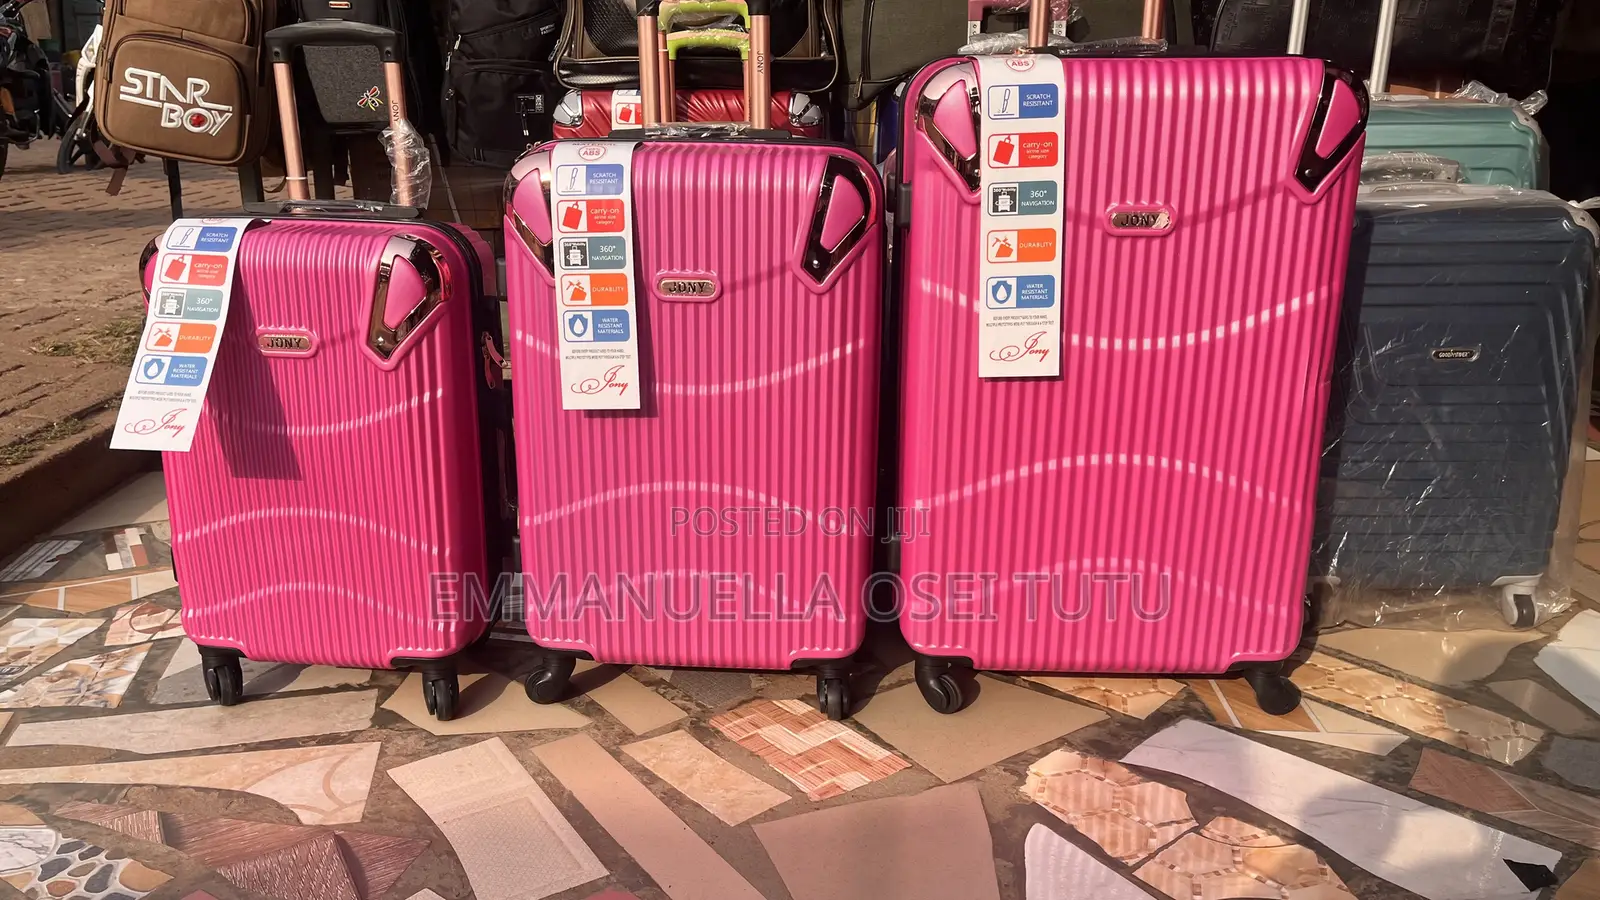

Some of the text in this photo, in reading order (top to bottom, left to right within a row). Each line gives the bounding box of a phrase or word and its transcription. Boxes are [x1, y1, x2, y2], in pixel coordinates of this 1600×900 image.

[756, 50, 765, 75] JONY
[120, 67, 232, 112] STAR
[391, 100, 400, 122] JONY
[161, 102, 233, 137] BOY
[1030, 190, 1048, 198] 360°
[590, 208, 620, 216] carry-on
[1121, 213, 1160, 226] JONY
[599, 245, 616, 253] 360°
[194, 262, 223, 270] carry-on
[669, 282, 706, 293] JONY
[196, 297, 213, 305] 360°
[267, 337, 301, 349] JONY
[989, 331, 1050, 362] Jony
[570, 364, 629, 396] Jony
[124, 408, 187, 438] Jony
